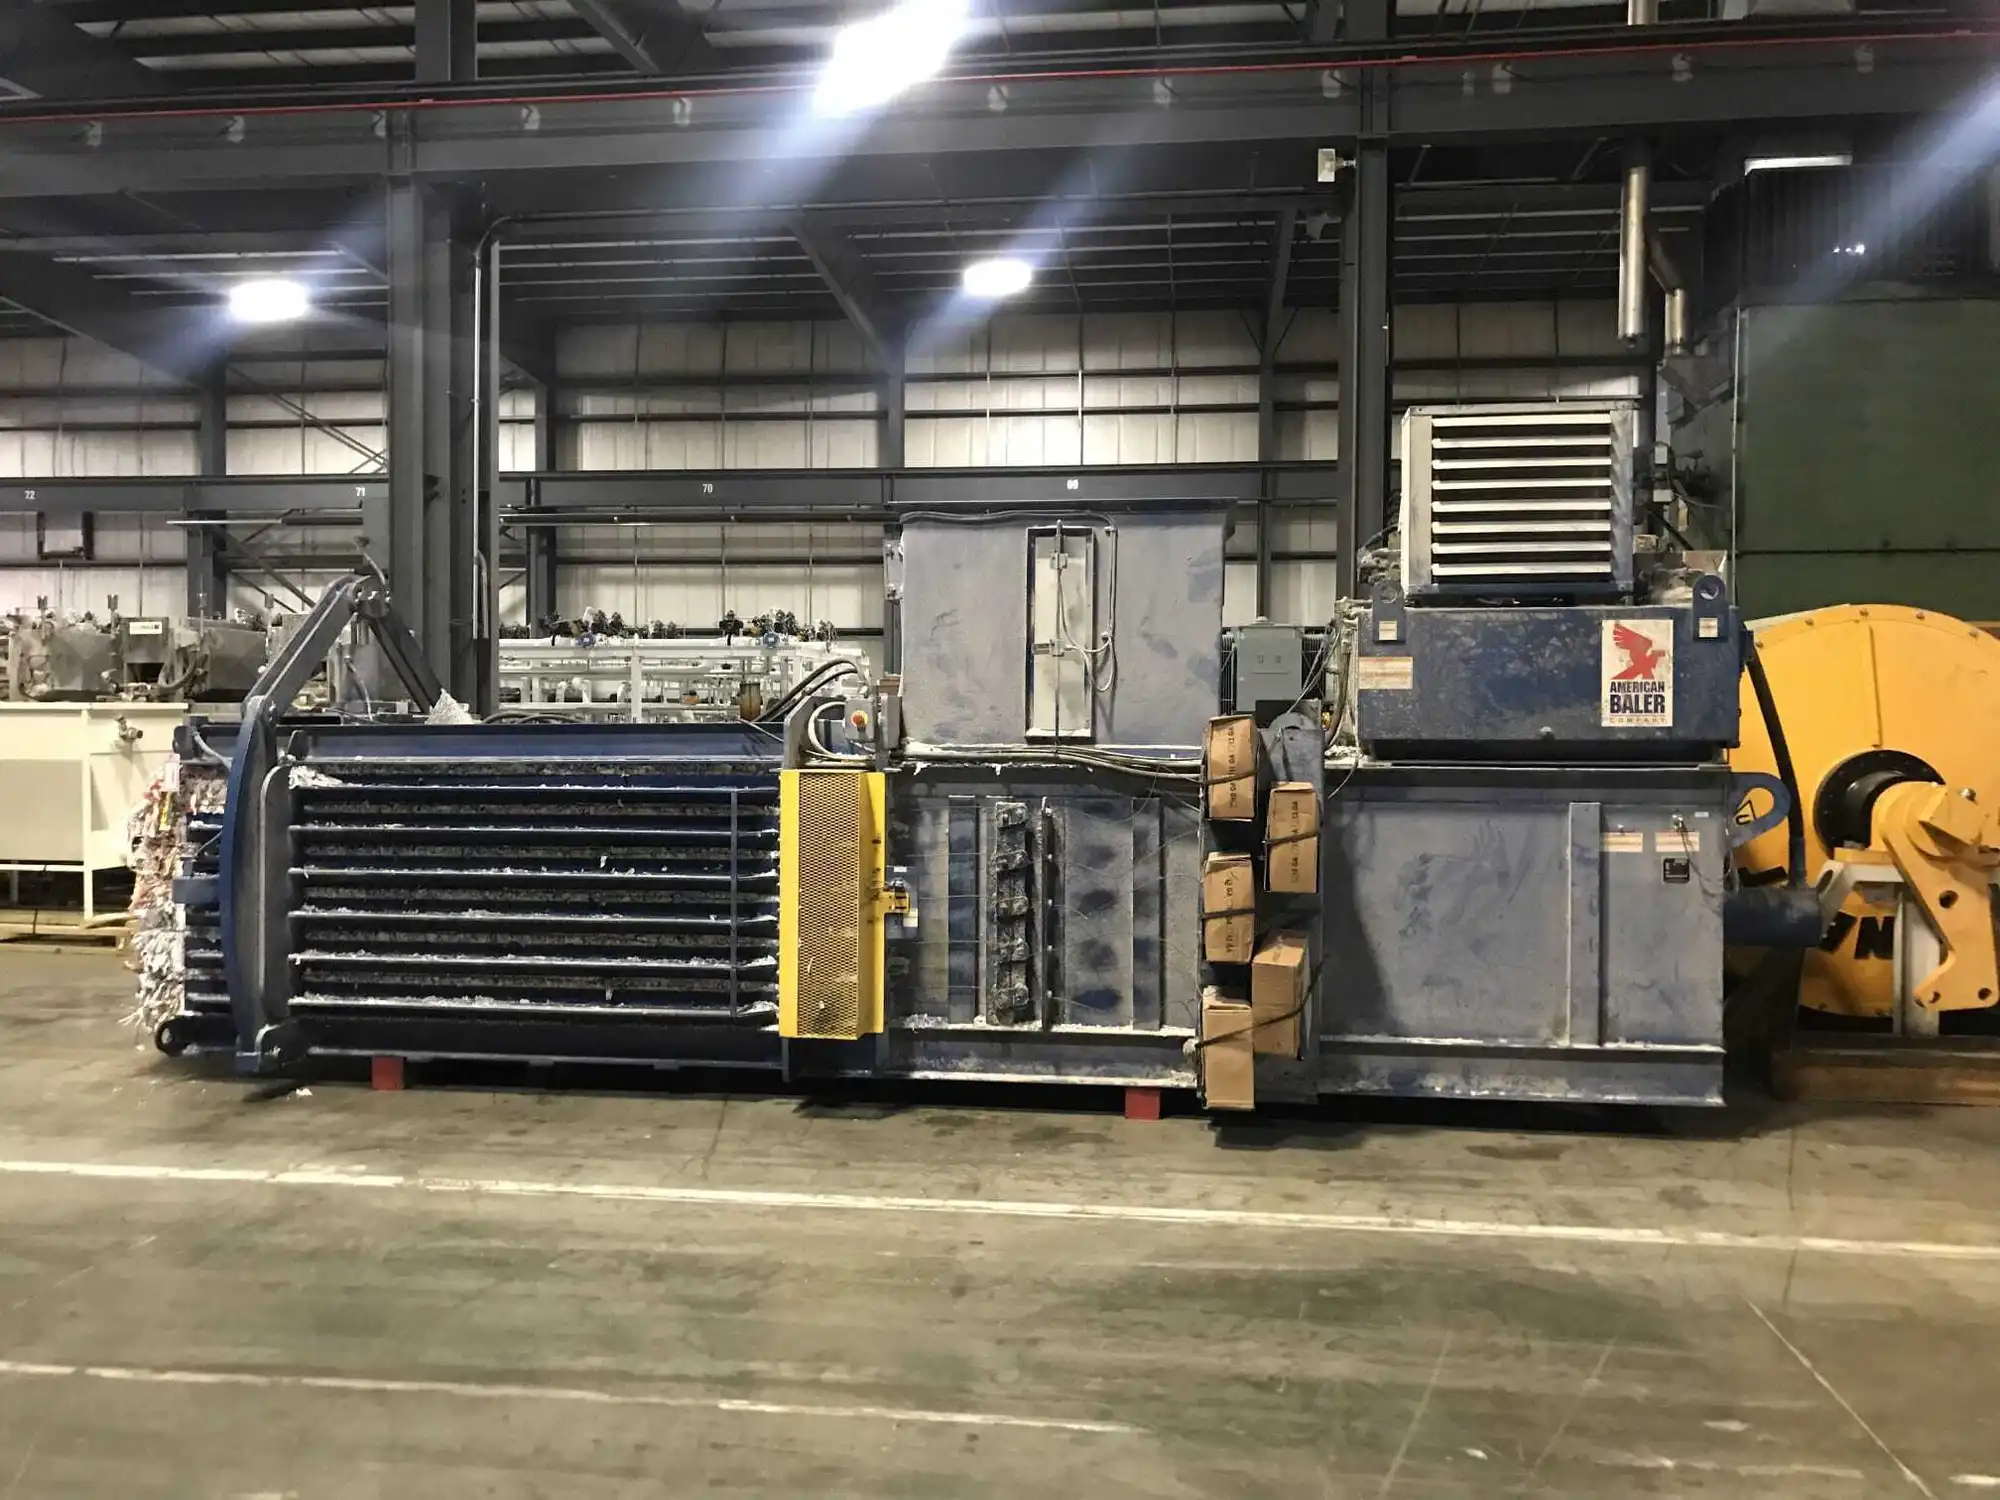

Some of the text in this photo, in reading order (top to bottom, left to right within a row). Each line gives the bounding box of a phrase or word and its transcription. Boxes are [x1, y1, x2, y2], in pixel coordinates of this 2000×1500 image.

[356, 487, 365, 496] 71
[703, 484, 713, 493] 70
[1610, 681, 1665, 693] AMERICAN
[1610, 694, 1666, 714] BALER
